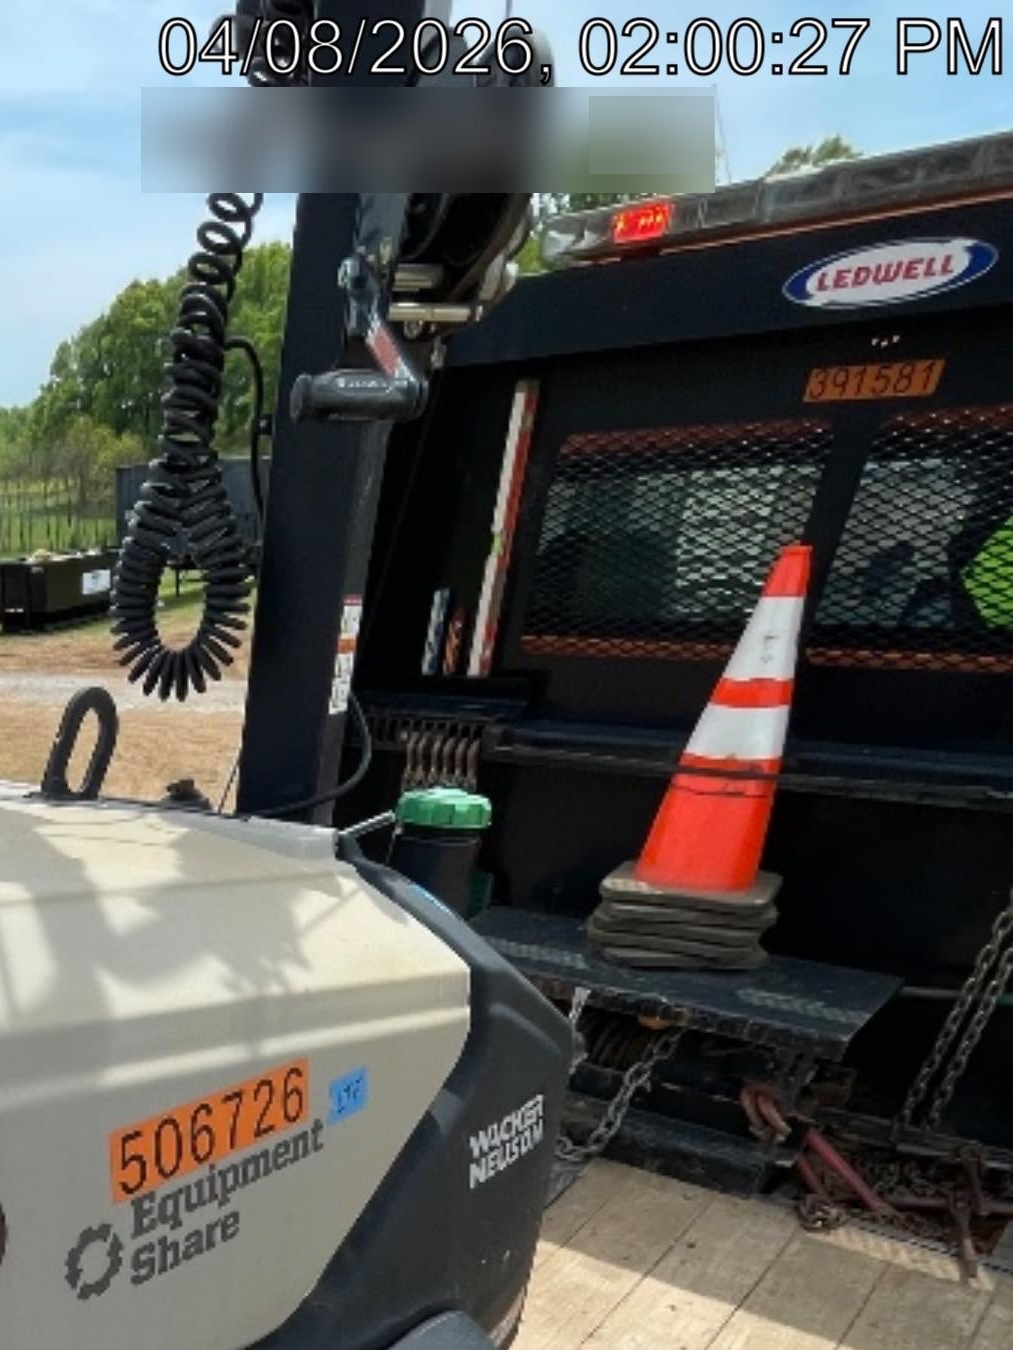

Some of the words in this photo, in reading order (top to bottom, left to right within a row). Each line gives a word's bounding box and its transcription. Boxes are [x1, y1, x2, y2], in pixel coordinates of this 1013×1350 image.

[814, 254, 955, 292] LEDWELL
[809, 361, 937, 398] 391581
[118, 1066, 305, 1196] 506726
[469, 1093, 544, 1159] WACKER
[469, 1119, 544, 1190] NEUSON
[130, 1117, 325, 1240] Equipment
[130, 1211, 241, 1287] Share
